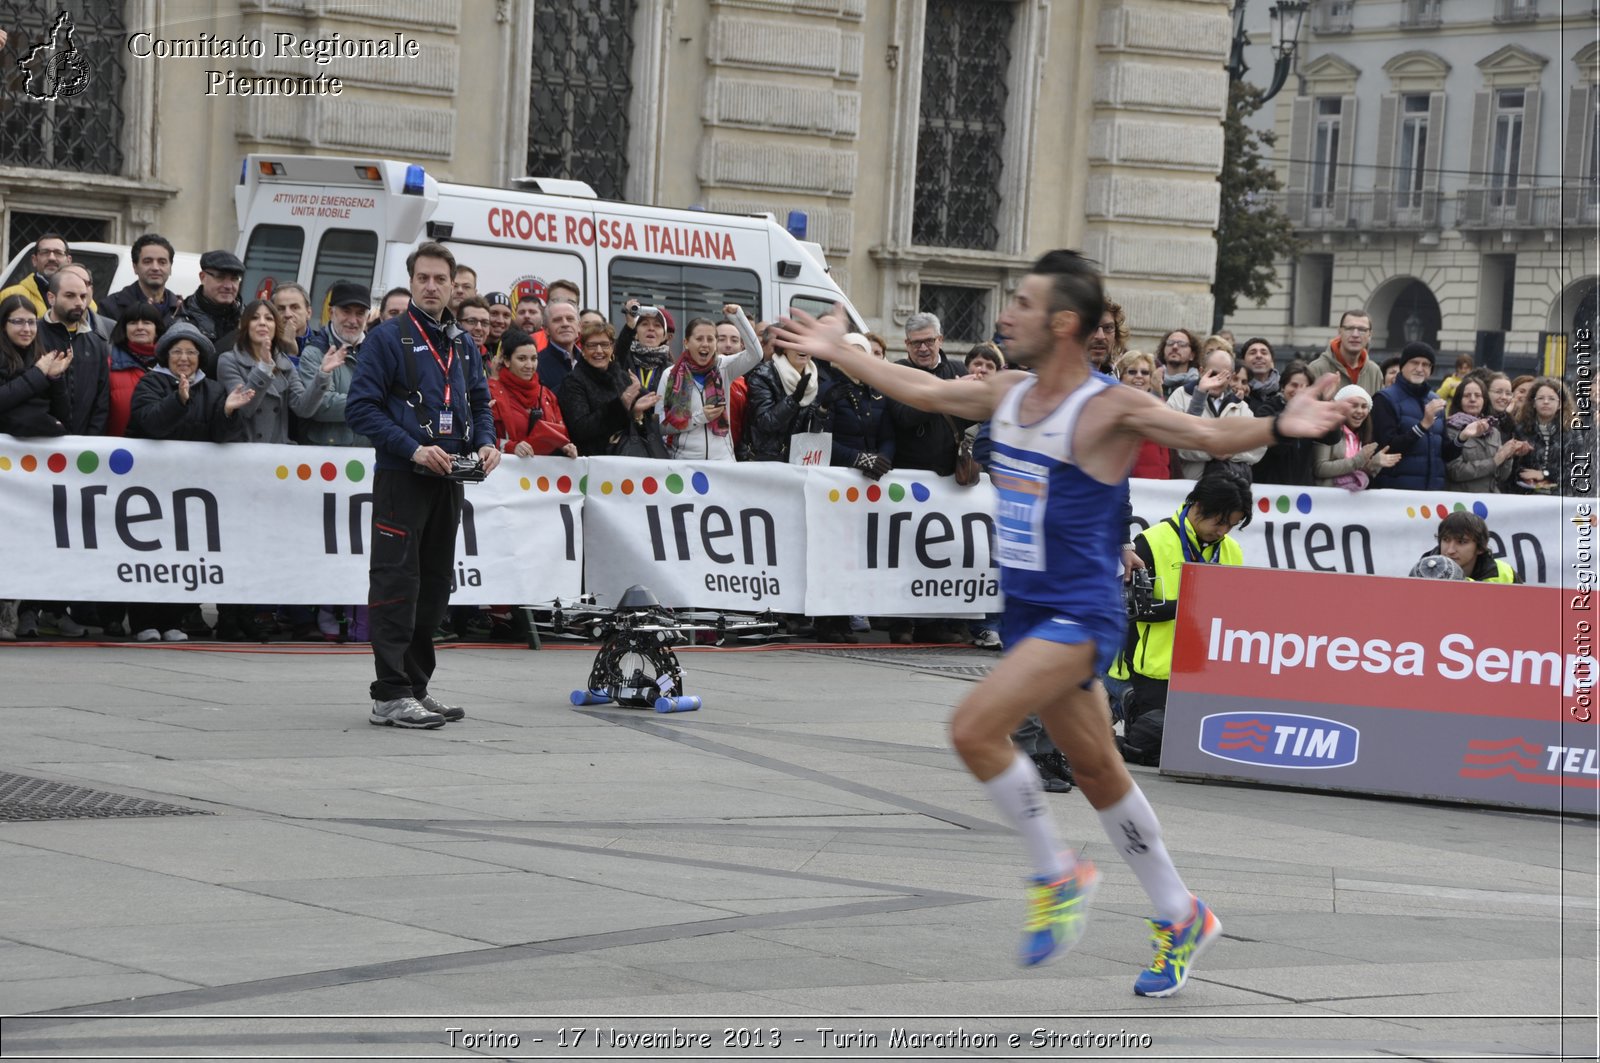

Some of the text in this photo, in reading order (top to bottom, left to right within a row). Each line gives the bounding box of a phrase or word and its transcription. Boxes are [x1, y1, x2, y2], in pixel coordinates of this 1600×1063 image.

[309, 195, 320, 205] DI
[320, 196, 375, 209] EMERGENZA
[316, 207, 351, 219] MOBILE
[487, 207, 737, 262] CROCE ROSSA ITALIANA
[52, 484, 222, 552] iren
[645, 503, 778, 567] iren
[866, 511, 999, 569] iren
[1264, 521, 1375, 575] iren
[116, 557, 225, 592] energia
[704, 570, 781, 601] energia
[910, 573, 999, 603] energia
[1207, 617, 1600, 698] Impresa Semp
[1274, 724, 1341, 760] TIM
